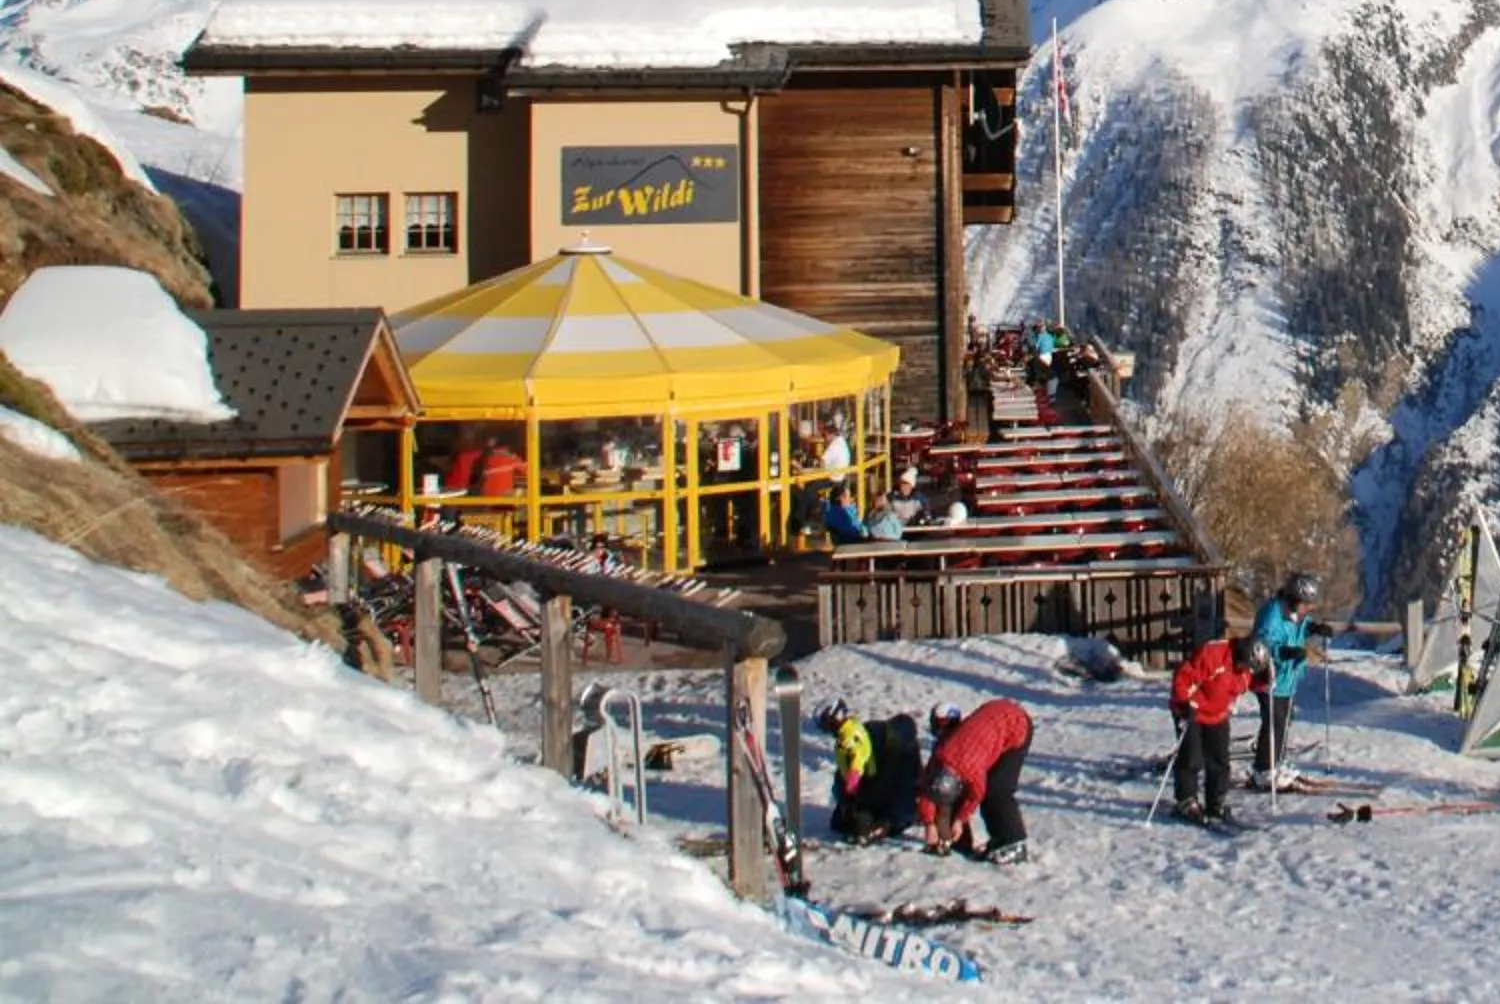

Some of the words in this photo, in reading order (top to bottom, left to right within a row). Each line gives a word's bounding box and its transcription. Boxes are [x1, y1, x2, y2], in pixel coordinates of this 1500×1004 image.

[572, 184, 615, 214] Zur
[617, 179, 695, 216] Wildi
[830, 913, 962, 982] NITRO
